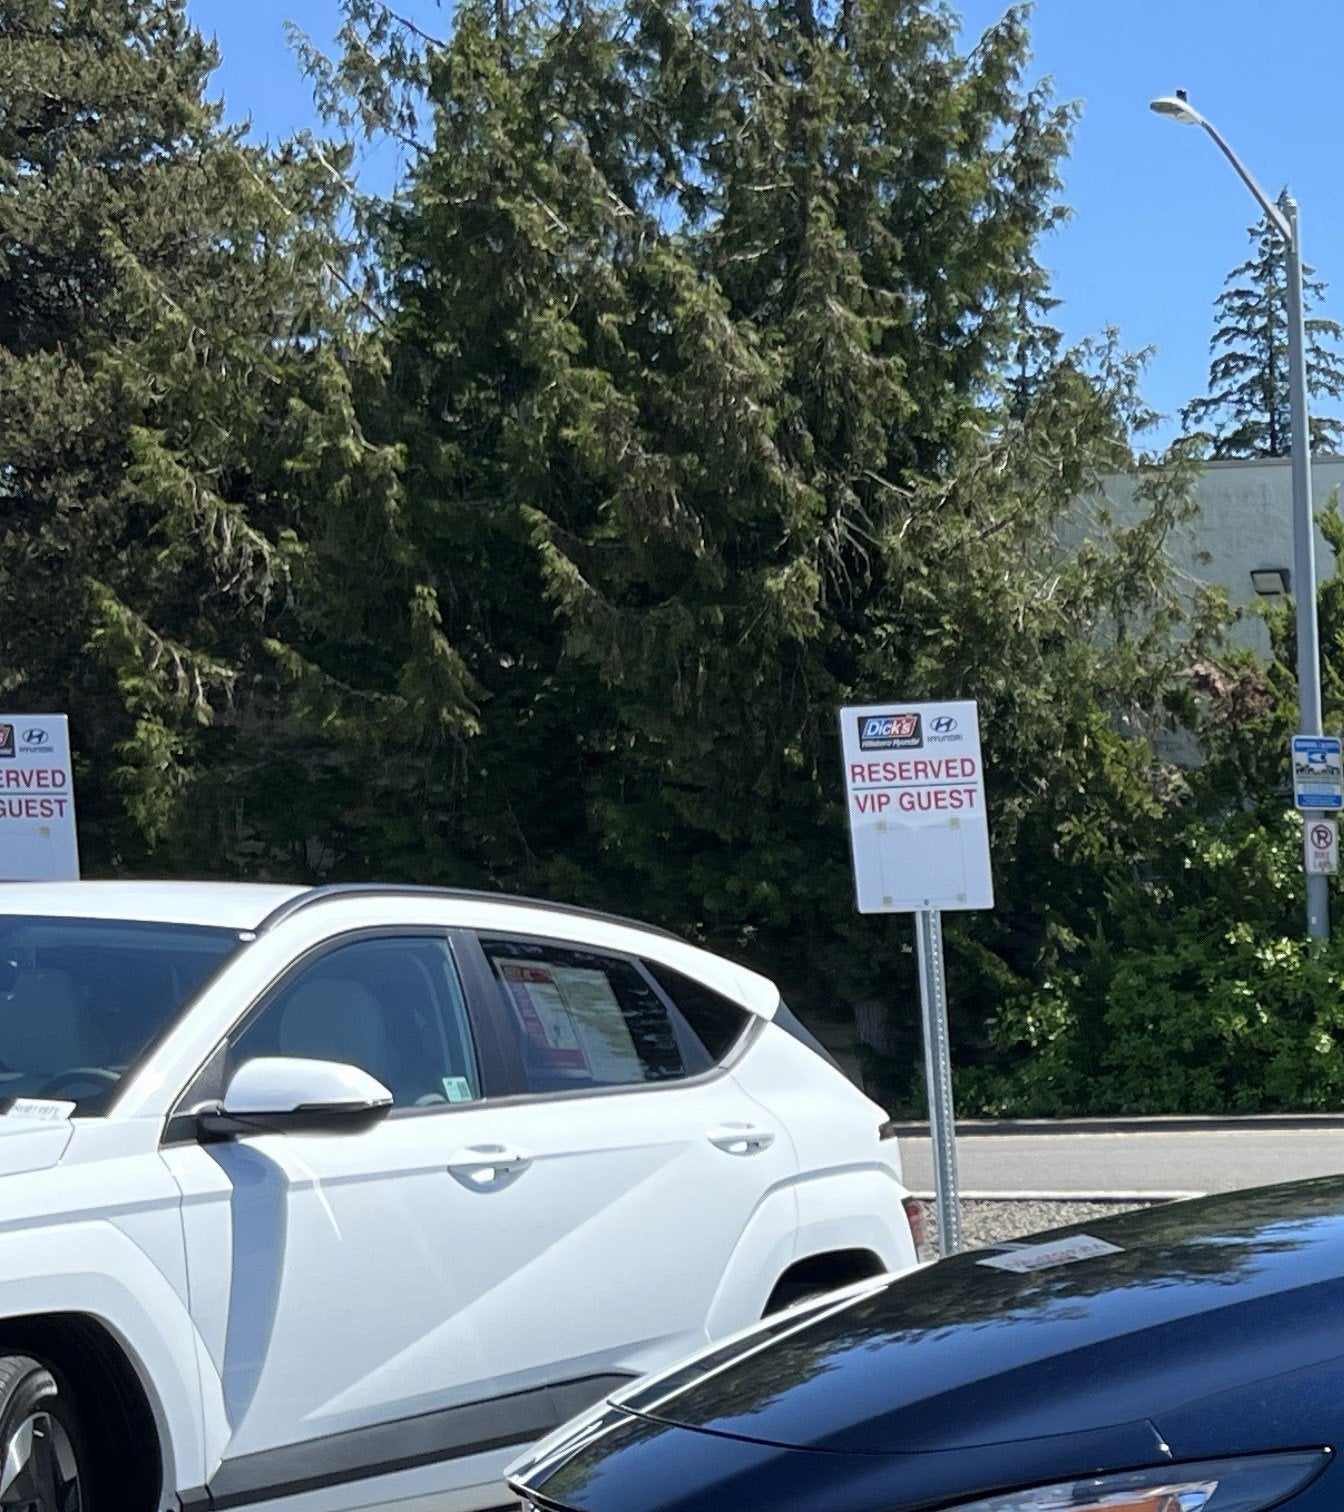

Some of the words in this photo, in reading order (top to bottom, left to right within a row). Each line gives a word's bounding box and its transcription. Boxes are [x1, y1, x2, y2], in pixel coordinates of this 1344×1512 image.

[0, 768, 67, 788] RVED
[850, 757, 977, 784] RESERVED
[854, 793, 891, 814] VIP
[899, 788, 978, 812] GUEST
